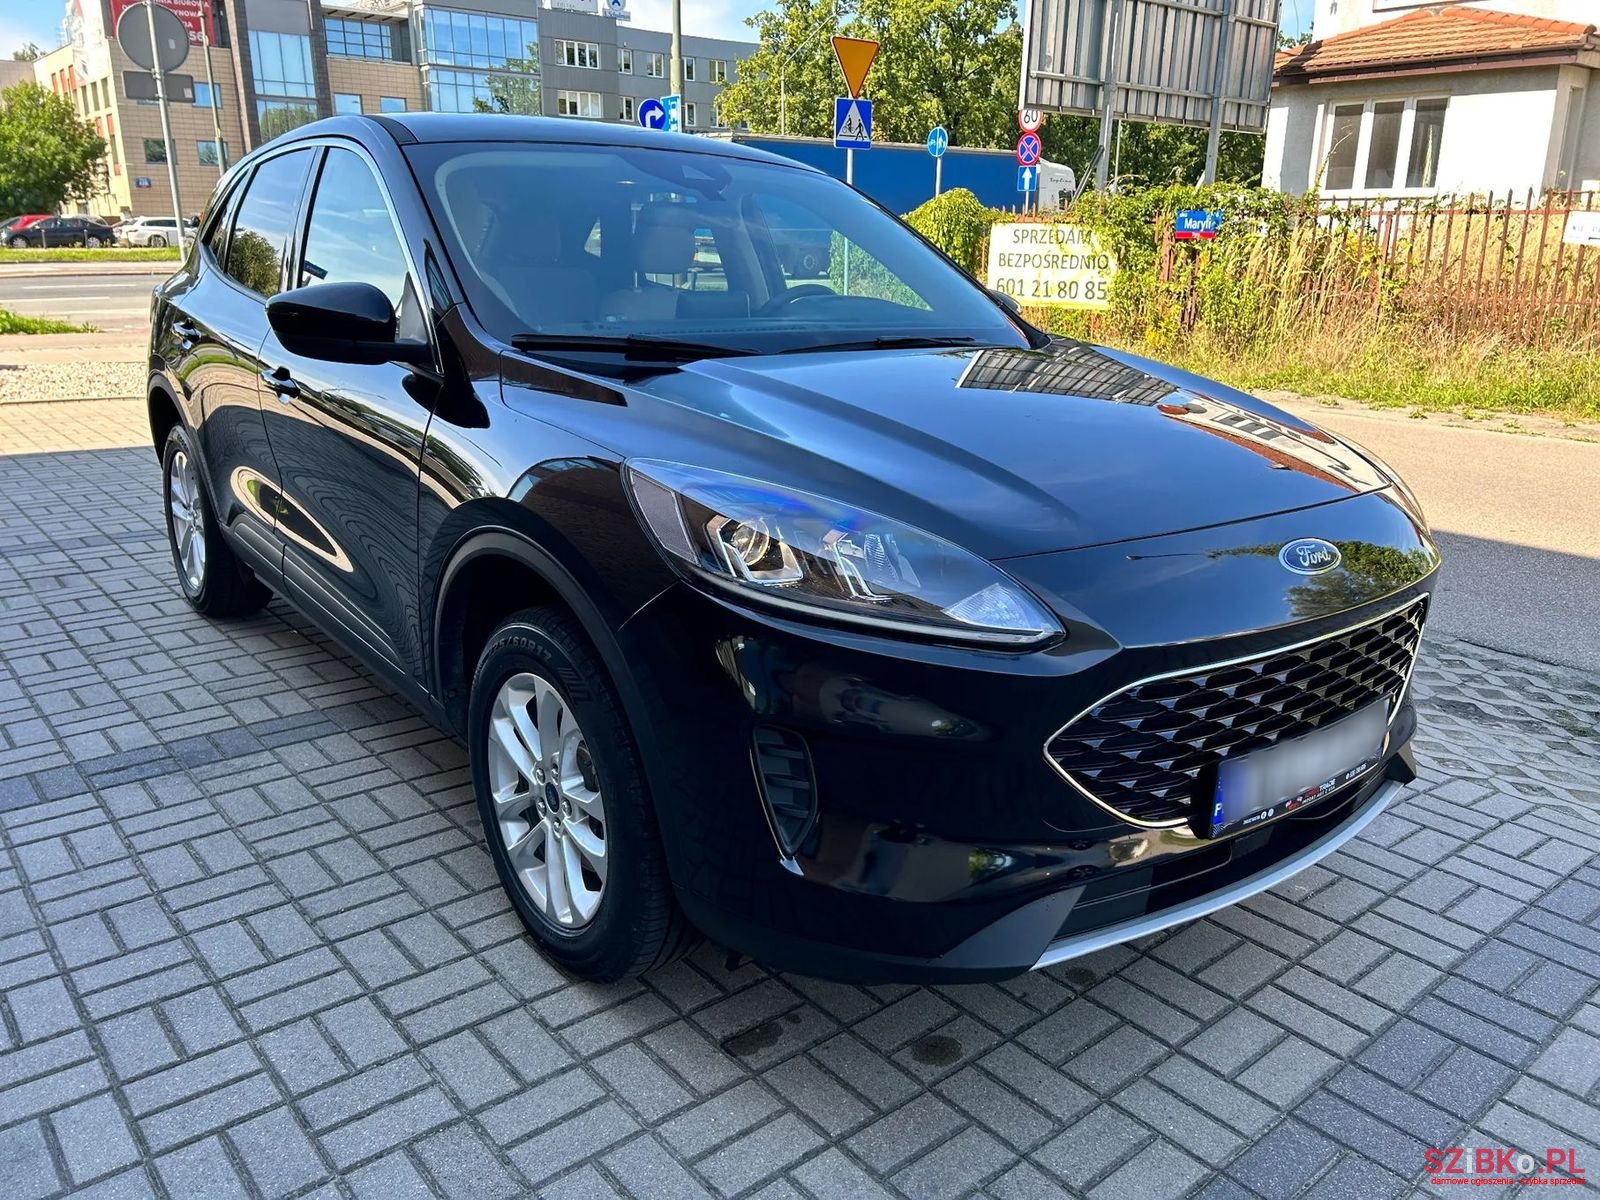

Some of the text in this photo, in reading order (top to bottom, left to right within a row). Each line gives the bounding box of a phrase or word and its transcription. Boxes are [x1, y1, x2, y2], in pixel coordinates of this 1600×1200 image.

[1024, 110, 1038, 124] 60
[1013, 229, 1092, 245] SPRZEDAM
[999, 250, 1109, 270] BEZPOŚREDNIO
[996, 278, 1108, 300] 601 21 80 85
[1296, 544, 1331, 567] Ford
[1214, 803, 1223, 816] P
